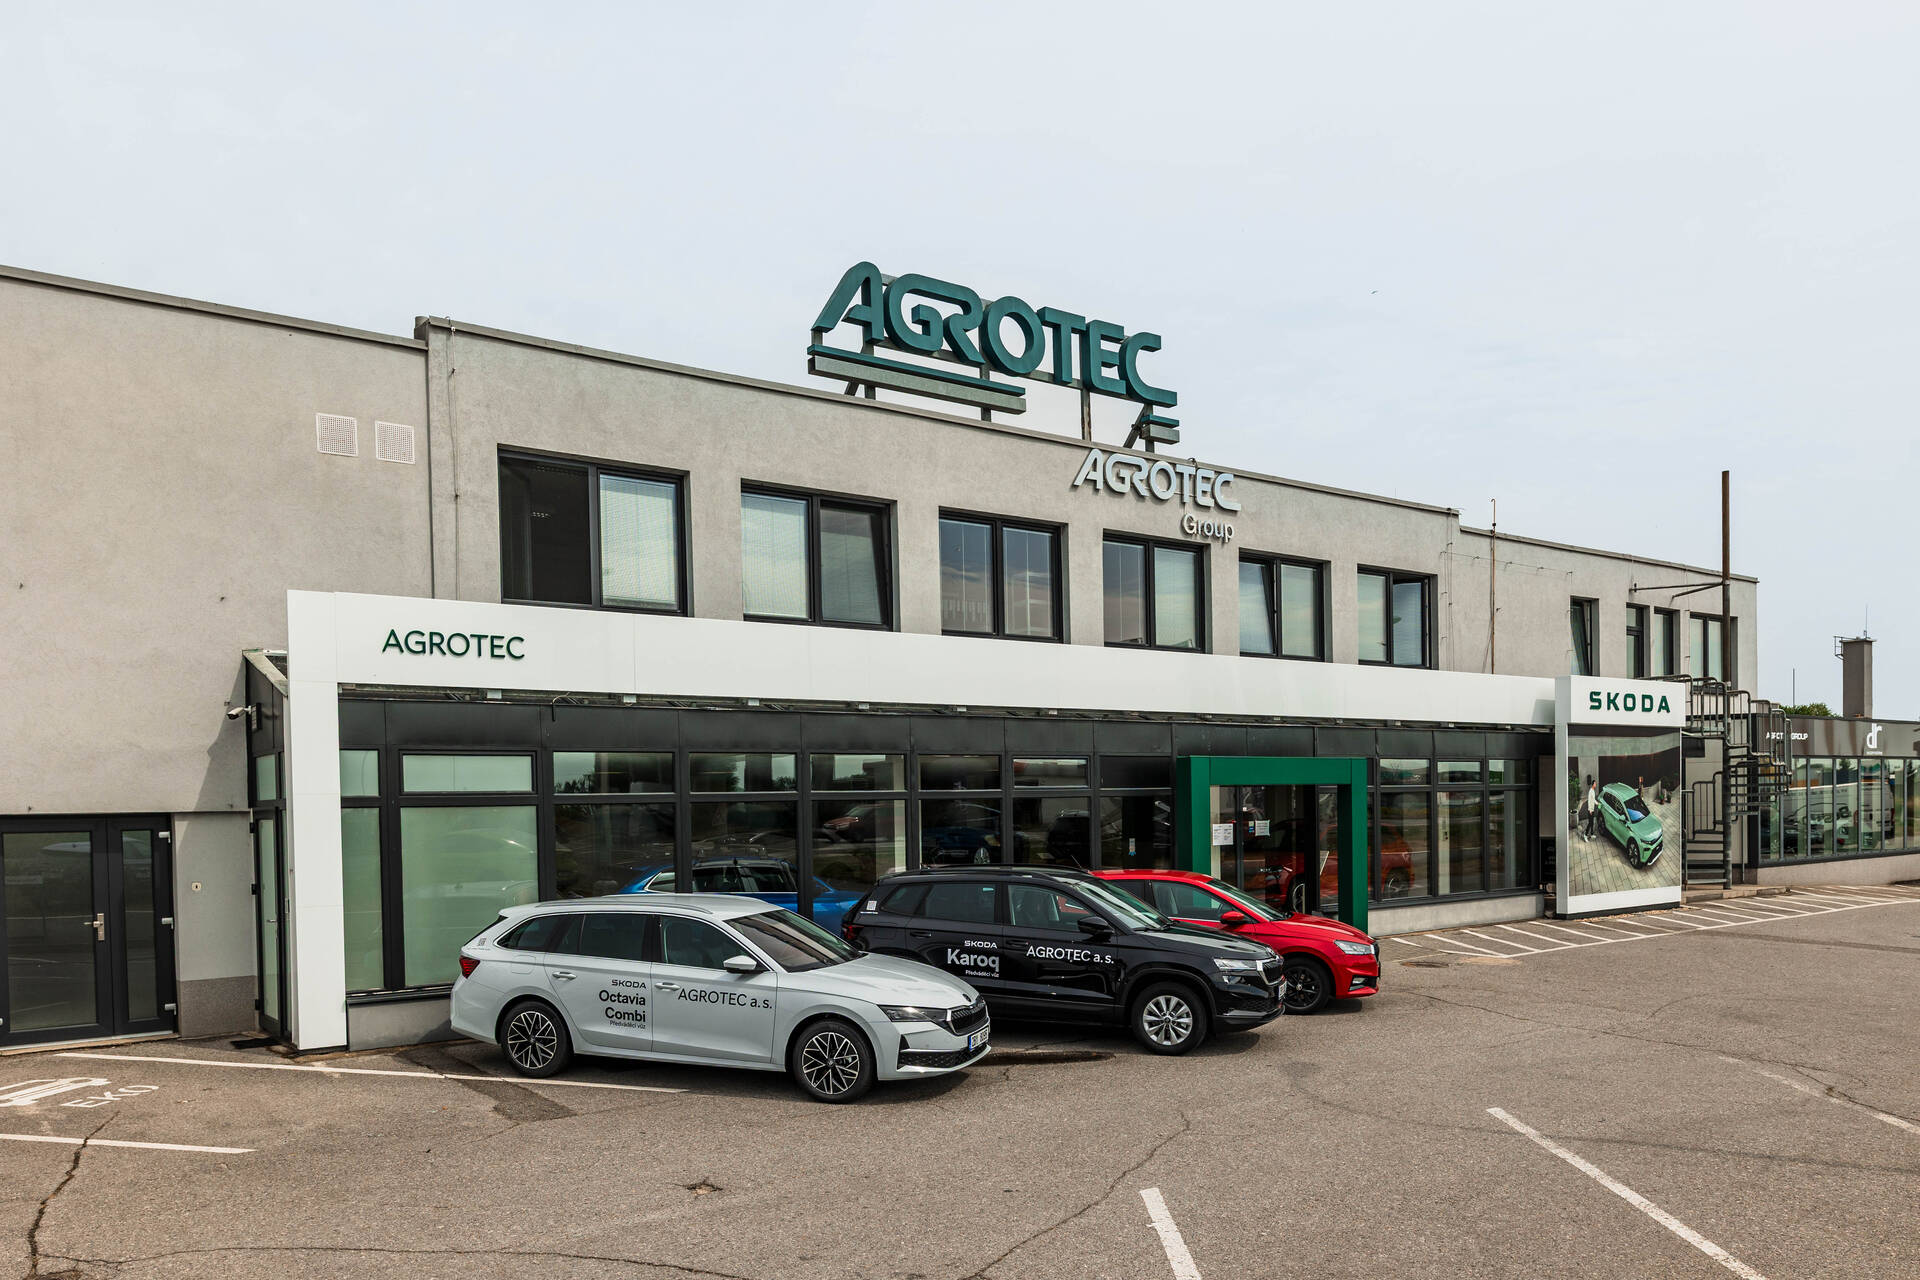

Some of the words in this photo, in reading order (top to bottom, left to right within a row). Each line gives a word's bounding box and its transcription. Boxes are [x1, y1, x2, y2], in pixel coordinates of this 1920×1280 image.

[811, 261, 1177, 406] AGROTEC
[1073, 449, 1241, 511] AGROTEC
[1181, 513, 1235, 542] Group
[382, 628, 525, 659] AGROTEC
[1589, 691, 1671, 713] SKODA
[964, 940, 998, 949] SKODA
[1026, 945, 1091, 962] AGROTEC
[947, 948, 1000, 972] Karoq
[611, 979, 647, 989] SKODA
[599, 989, 646, 1006] Octavia
[678, 988, 747, 1007] AGROTEC
[605, 1006, 646, 1022] Combi
[60, 1085, 159, 1108] EKO
